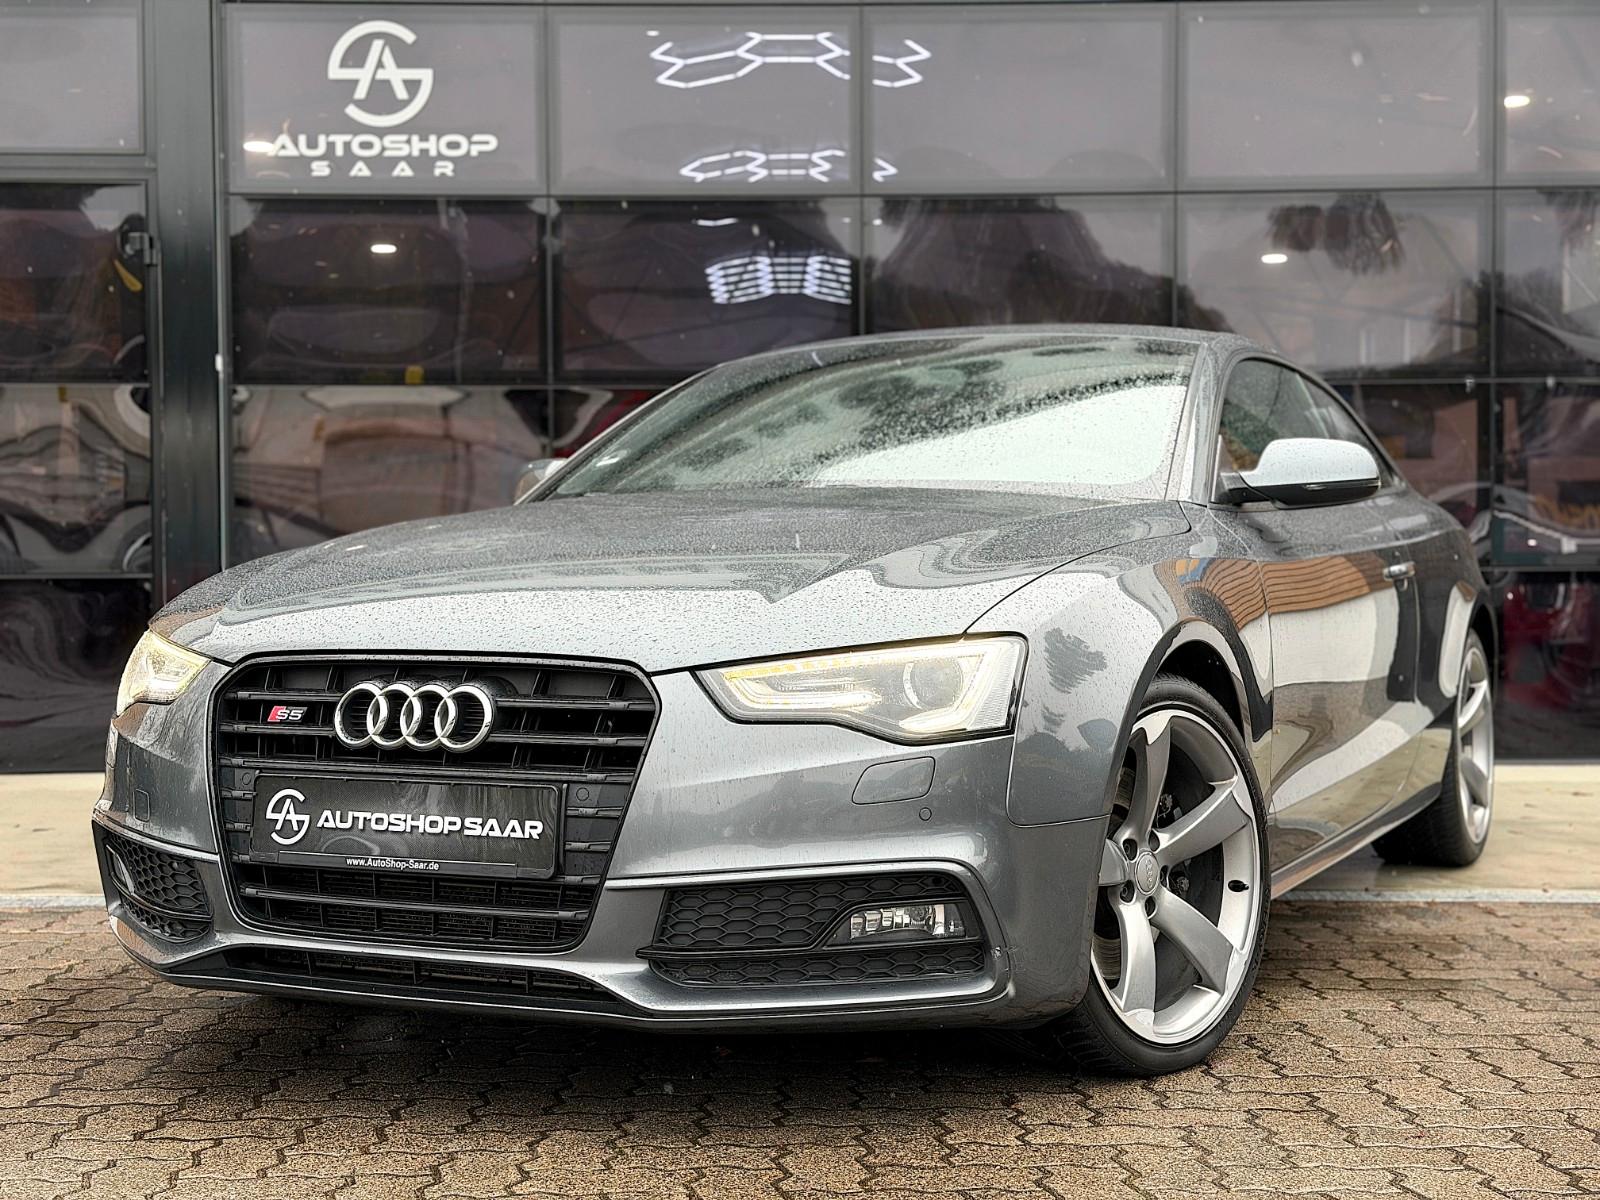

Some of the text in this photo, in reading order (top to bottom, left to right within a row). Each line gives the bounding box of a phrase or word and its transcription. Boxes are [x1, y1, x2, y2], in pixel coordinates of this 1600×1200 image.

[267, 134, 499, 157] AUTOSHOP
[310, 160, 455, 177] SAAR
[275, 709, 304, 721] S5
[346, 857, 440, 871] www.AutoShop-Saar.de
